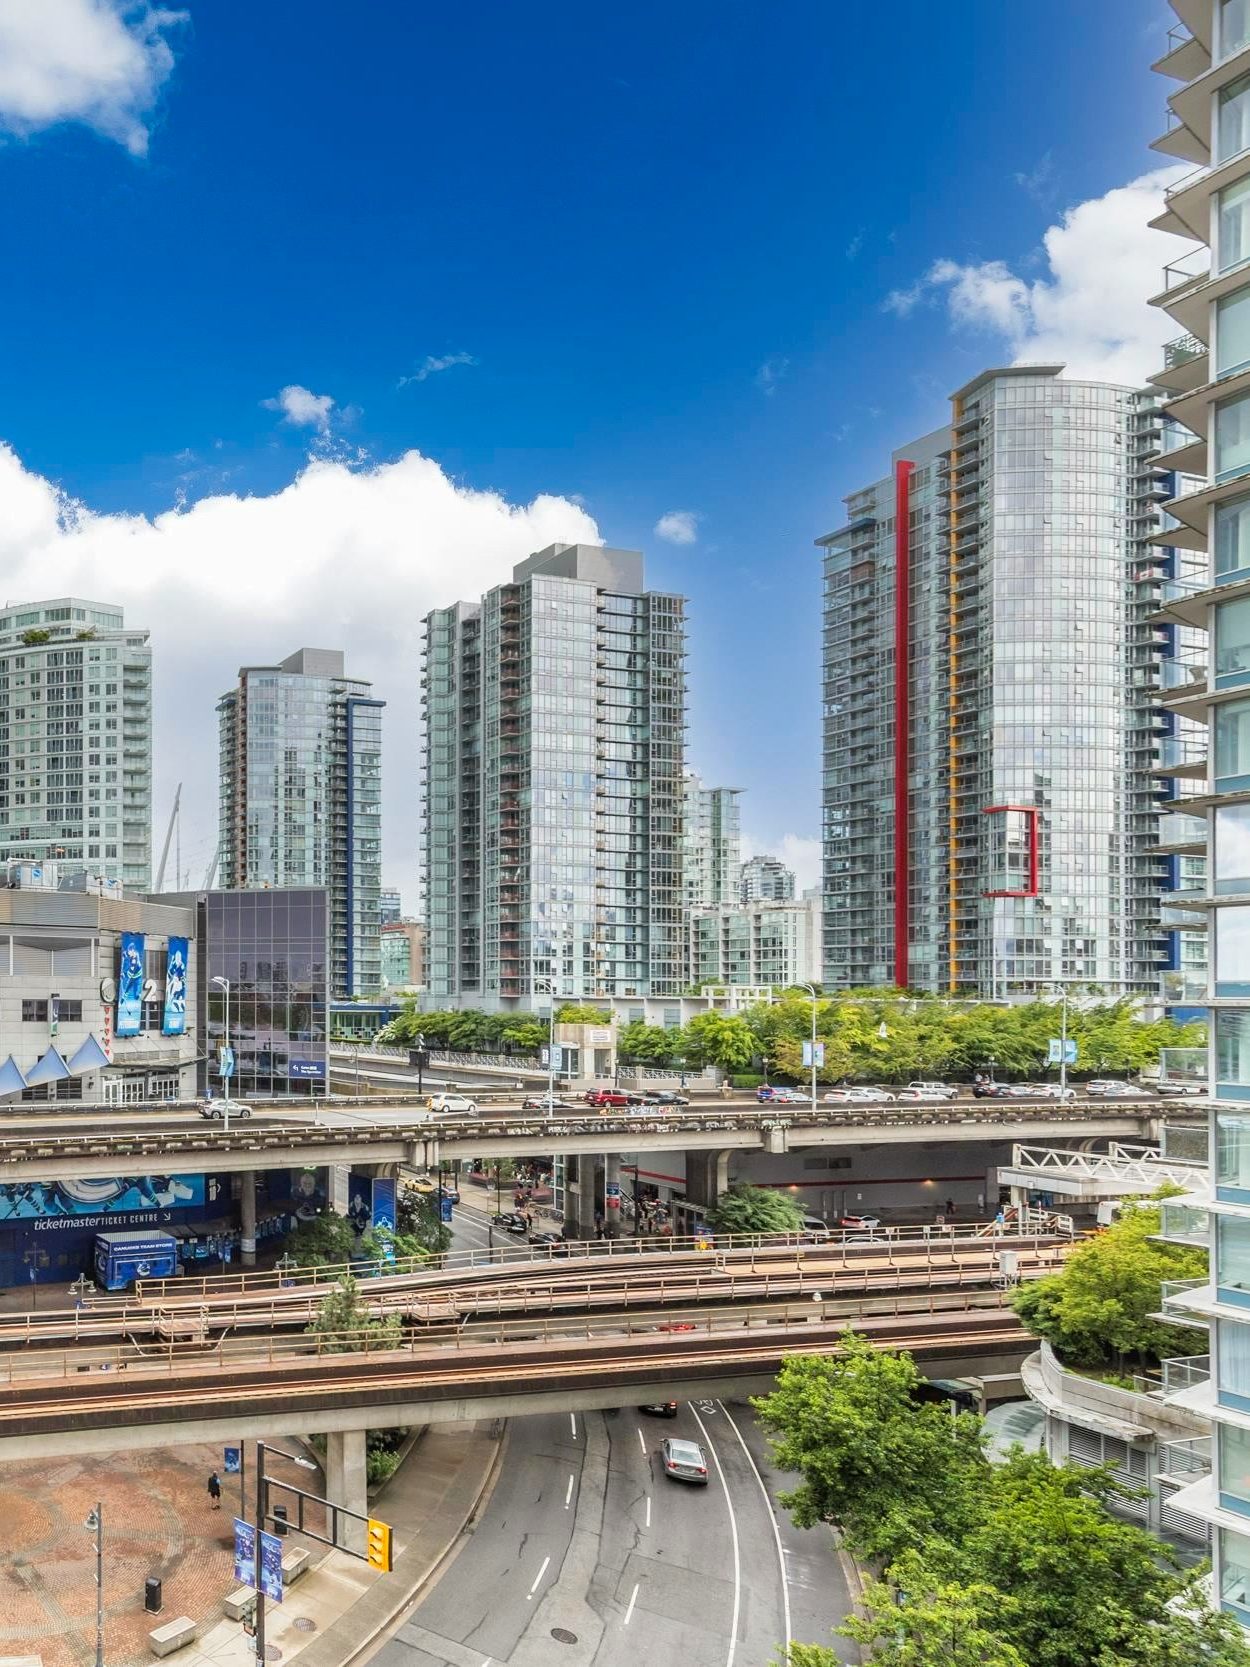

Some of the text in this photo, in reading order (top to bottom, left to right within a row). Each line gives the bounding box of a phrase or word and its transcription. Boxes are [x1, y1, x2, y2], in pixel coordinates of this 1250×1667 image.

[143, 978, 158, 1002] 2
[34, 1213, 158, 1231] ticketmaster TICKET CENTRE
